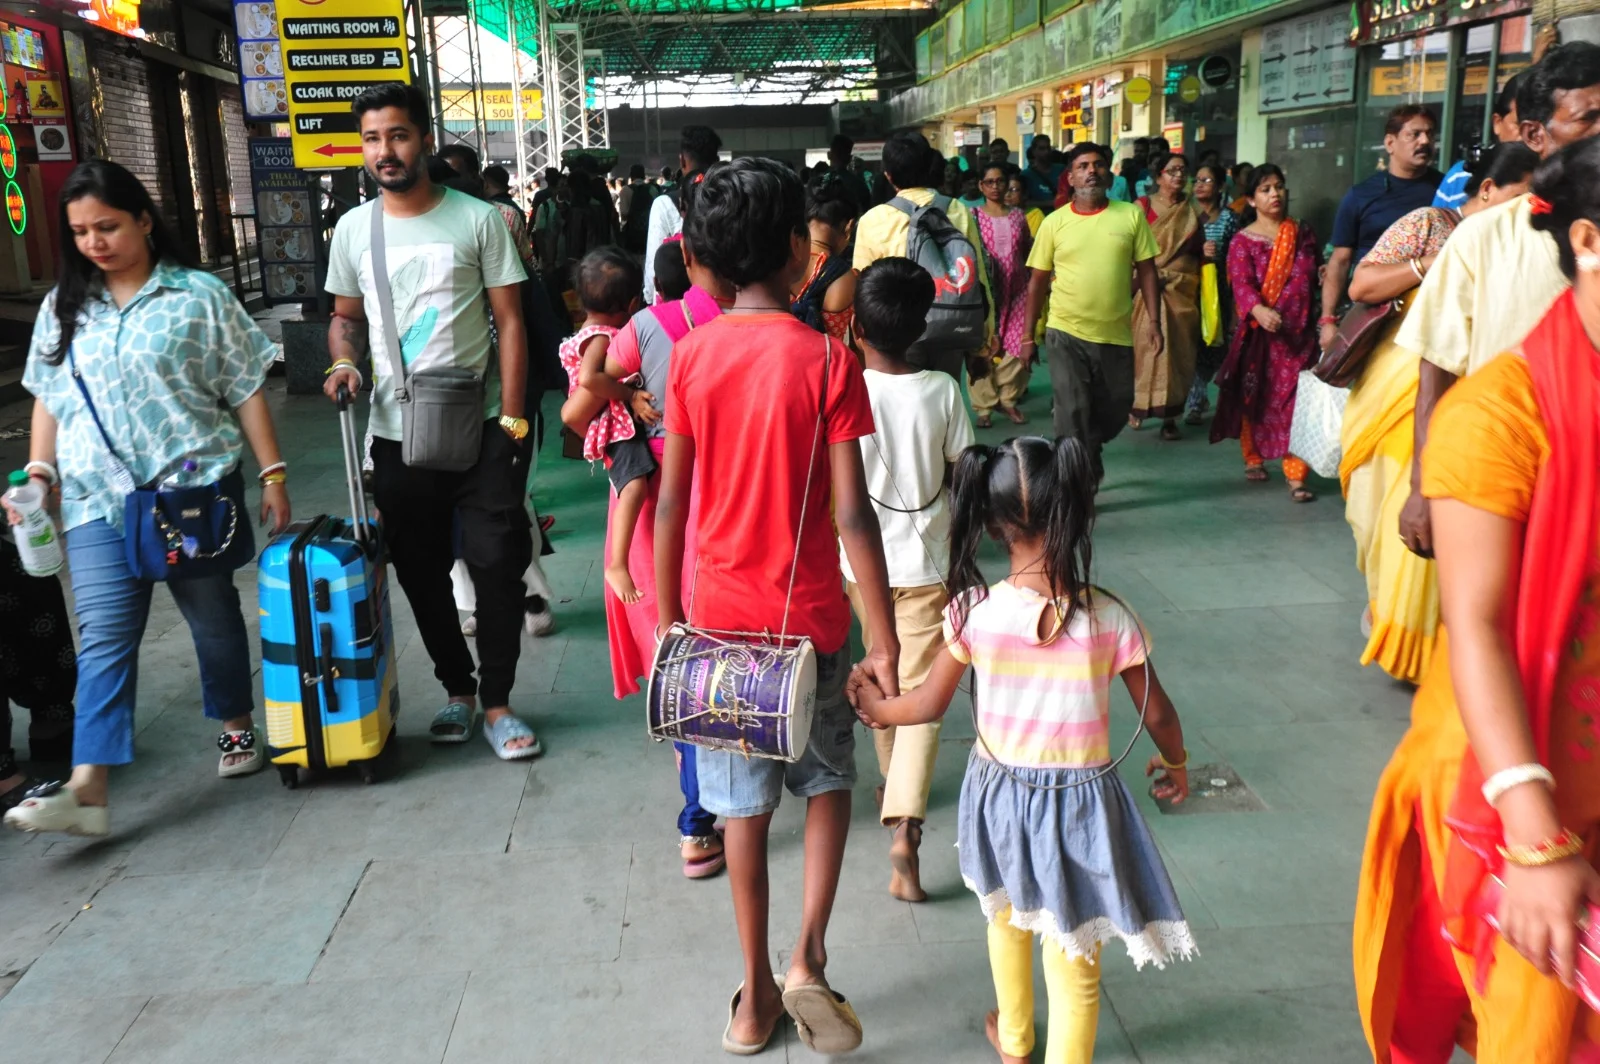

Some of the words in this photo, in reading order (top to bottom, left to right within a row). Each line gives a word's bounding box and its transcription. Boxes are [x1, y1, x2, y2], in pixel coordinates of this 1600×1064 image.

[287, 22, 341, 36] WAITING
[343, 22, 380, 35] ROOM
[291, 54, 348, 67] RECLINER
[350, 53, 376, 65] BED
[295, 86, 335, 99] CLOAK
[336, 85, 371, 99] ROO
[485, 94, 532, 105] SEALAH
[299, 118, 323, 130] LIFT
